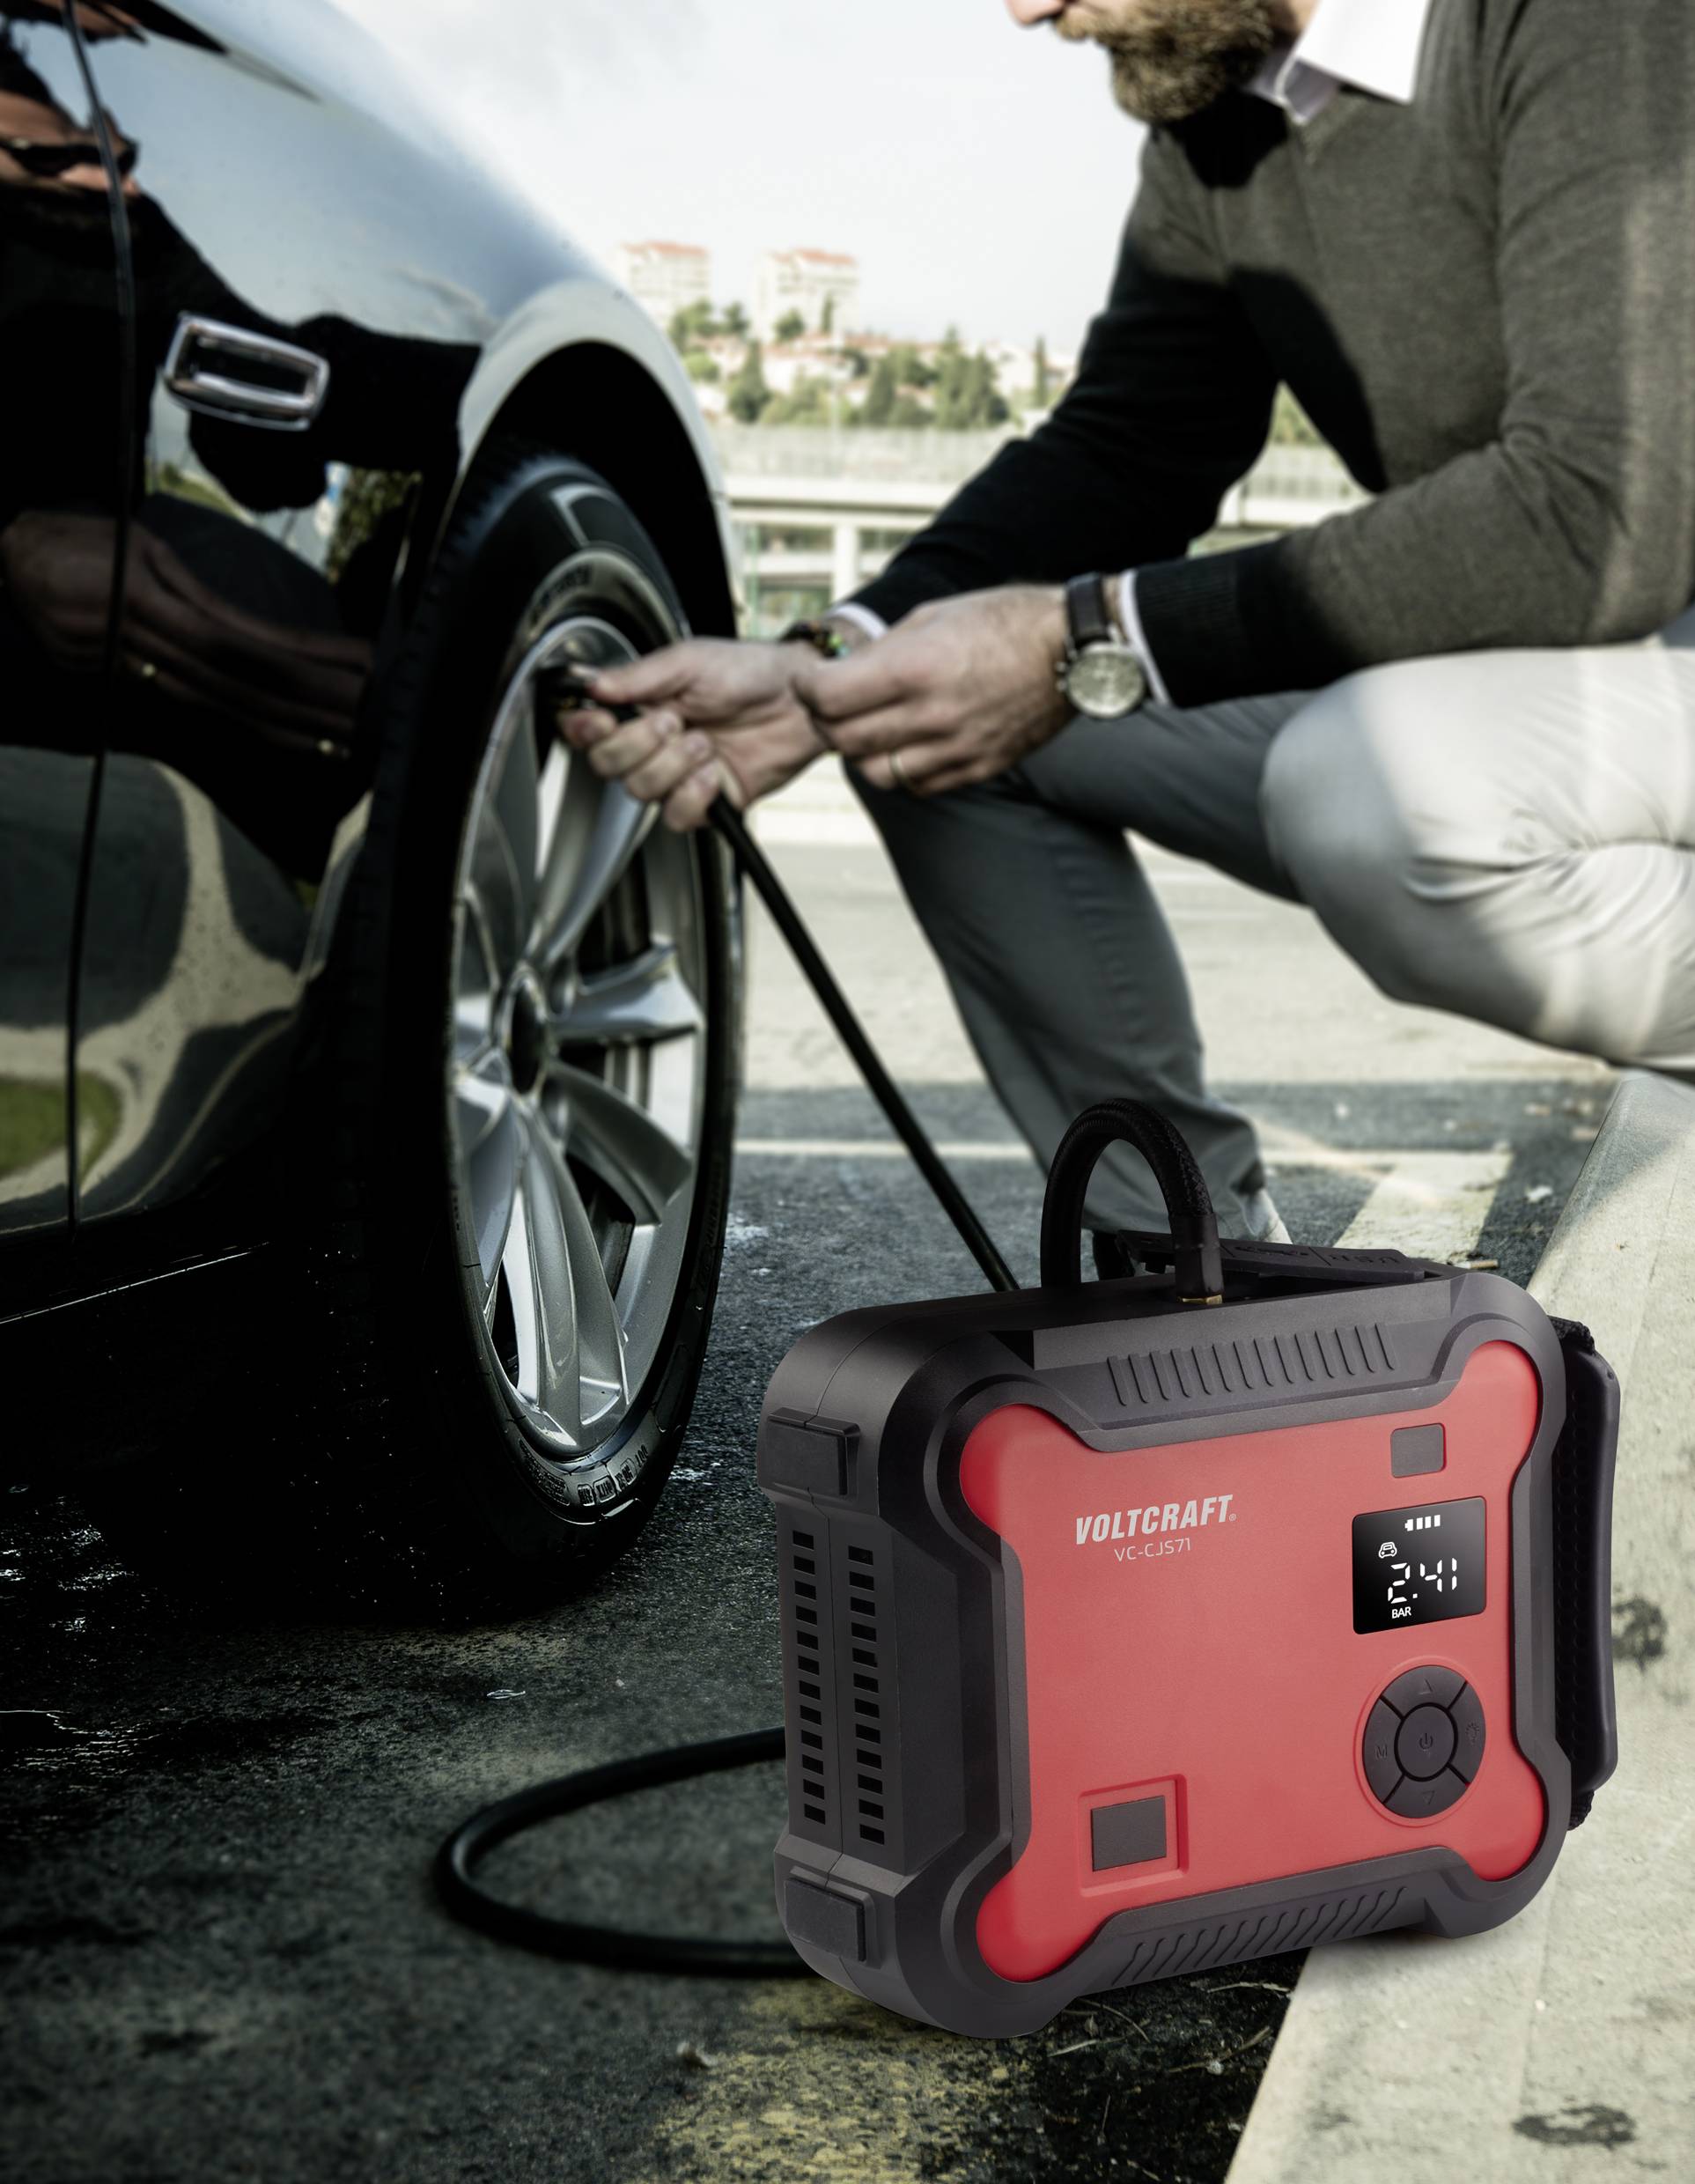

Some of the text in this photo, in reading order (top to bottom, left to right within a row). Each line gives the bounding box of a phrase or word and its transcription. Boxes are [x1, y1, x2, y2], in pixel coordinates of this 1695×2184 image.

[1114, 1538, 1191, 1561] VC-CJS71
[1388, 1557, 1457, 1604] 2.41
[1391, 1606, 1411, 1619] BAR
